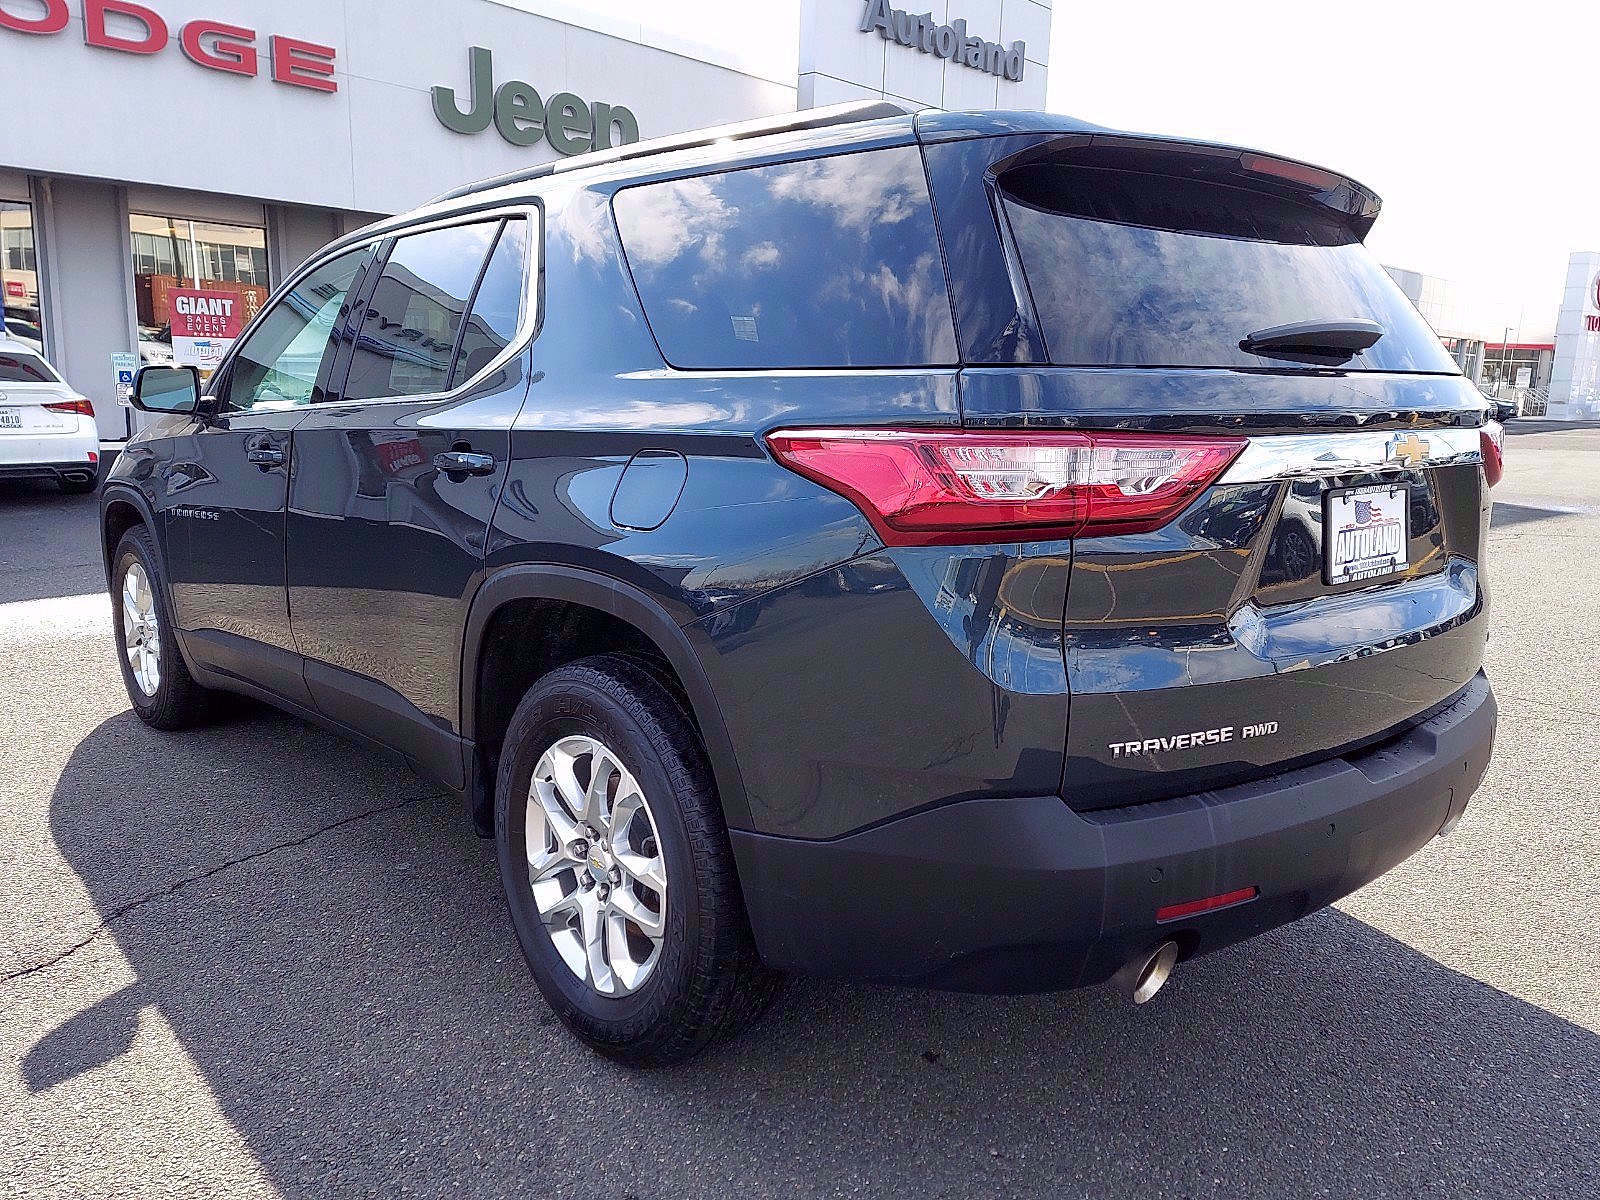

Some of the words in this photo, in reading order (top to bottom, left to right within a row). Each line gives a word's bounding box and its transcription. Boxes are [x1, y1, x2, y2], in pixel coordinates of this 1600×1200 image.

[859, 0, 1026, 82] Autoland
[431, 46, 640, 156] Jeep
[175, 296, 234, 317] GIANT
[186, 315, 226, 324] SALES
[187, 323, 227, 332] EVENT
[1334, 522, 1401, 567] AUTOLAND
[1351, 566, 1393, 582] AUTOLAND
[1108, 726, 1234, 759] TRAVERSE
[1242, 721, 1279, 740] AWD
